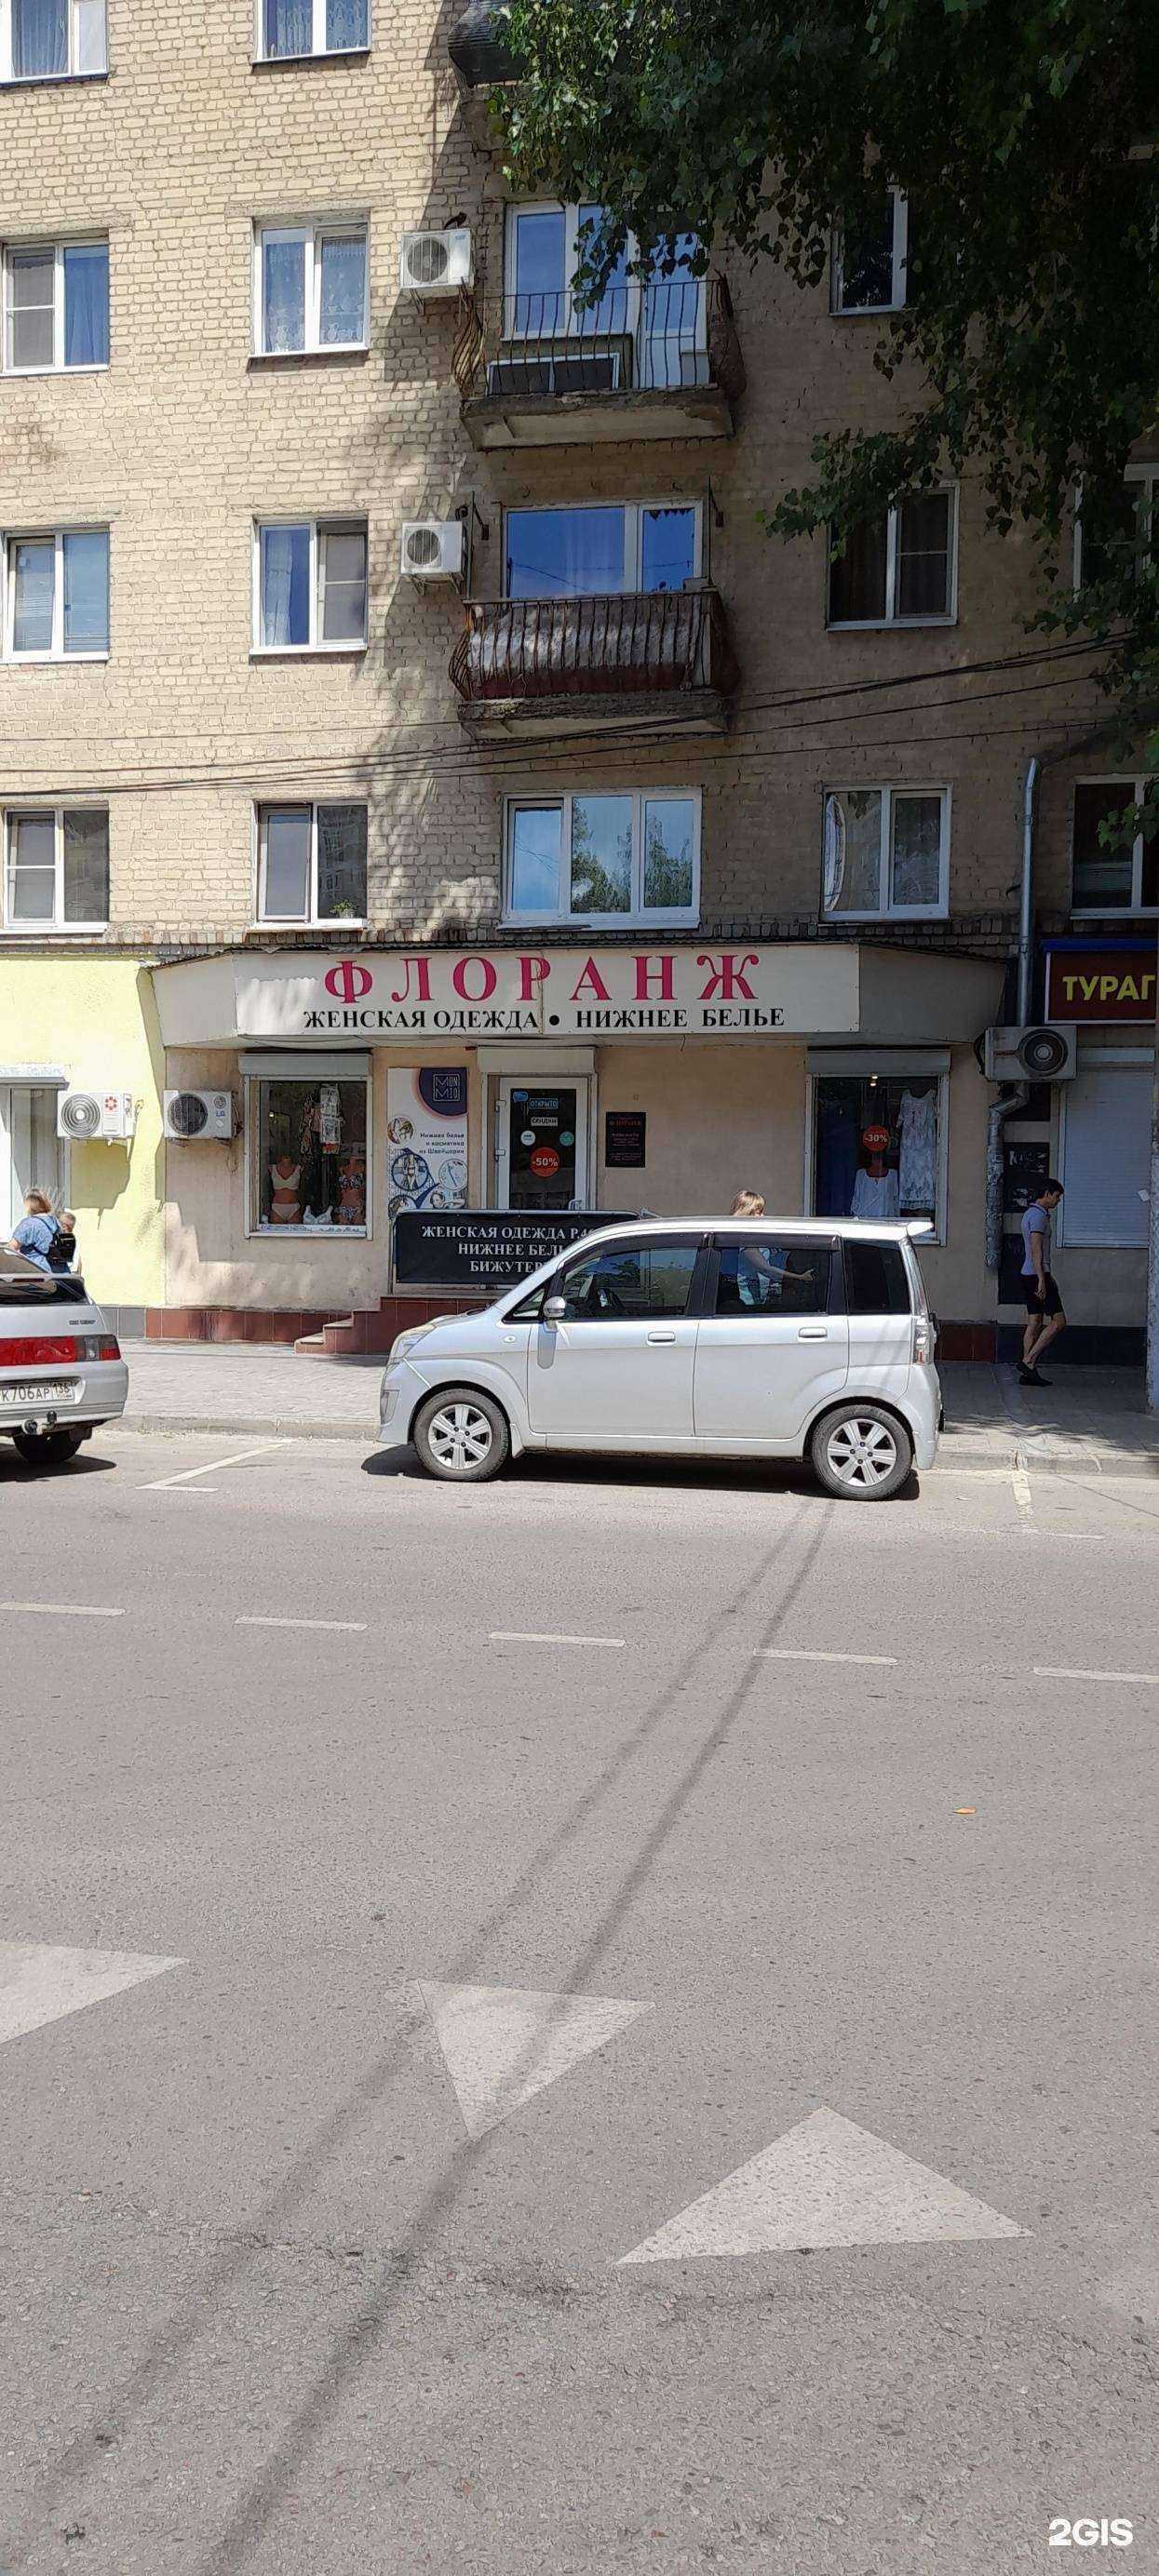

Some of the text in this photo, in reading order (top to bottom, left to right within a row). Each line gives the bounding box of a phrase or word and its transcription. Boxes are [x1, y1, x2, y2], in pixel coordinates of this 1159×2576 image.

[324, 954, 760, 1004] ФЛОРАНЖ
[1062, 974, 1155, 1001] ТУРАГ
[303, 1007, 786, 1031] ЖЕНСКАЯ ОДЕЖДА НИЖНЕЕ БЕЛЬЕ
[865, 1134, 888, 1143] -30%
[532, 1157, 559, 1167] -50%
[421, 1226, 497, 1239] ЖЕНСКАЯ
[501, 1227, 566, 1241] ОДЕЖДА
[458, 1242, 525, 1256] НИЖНЕЕ
[469, 1260, 544, 1273] БИЖУТЕР
